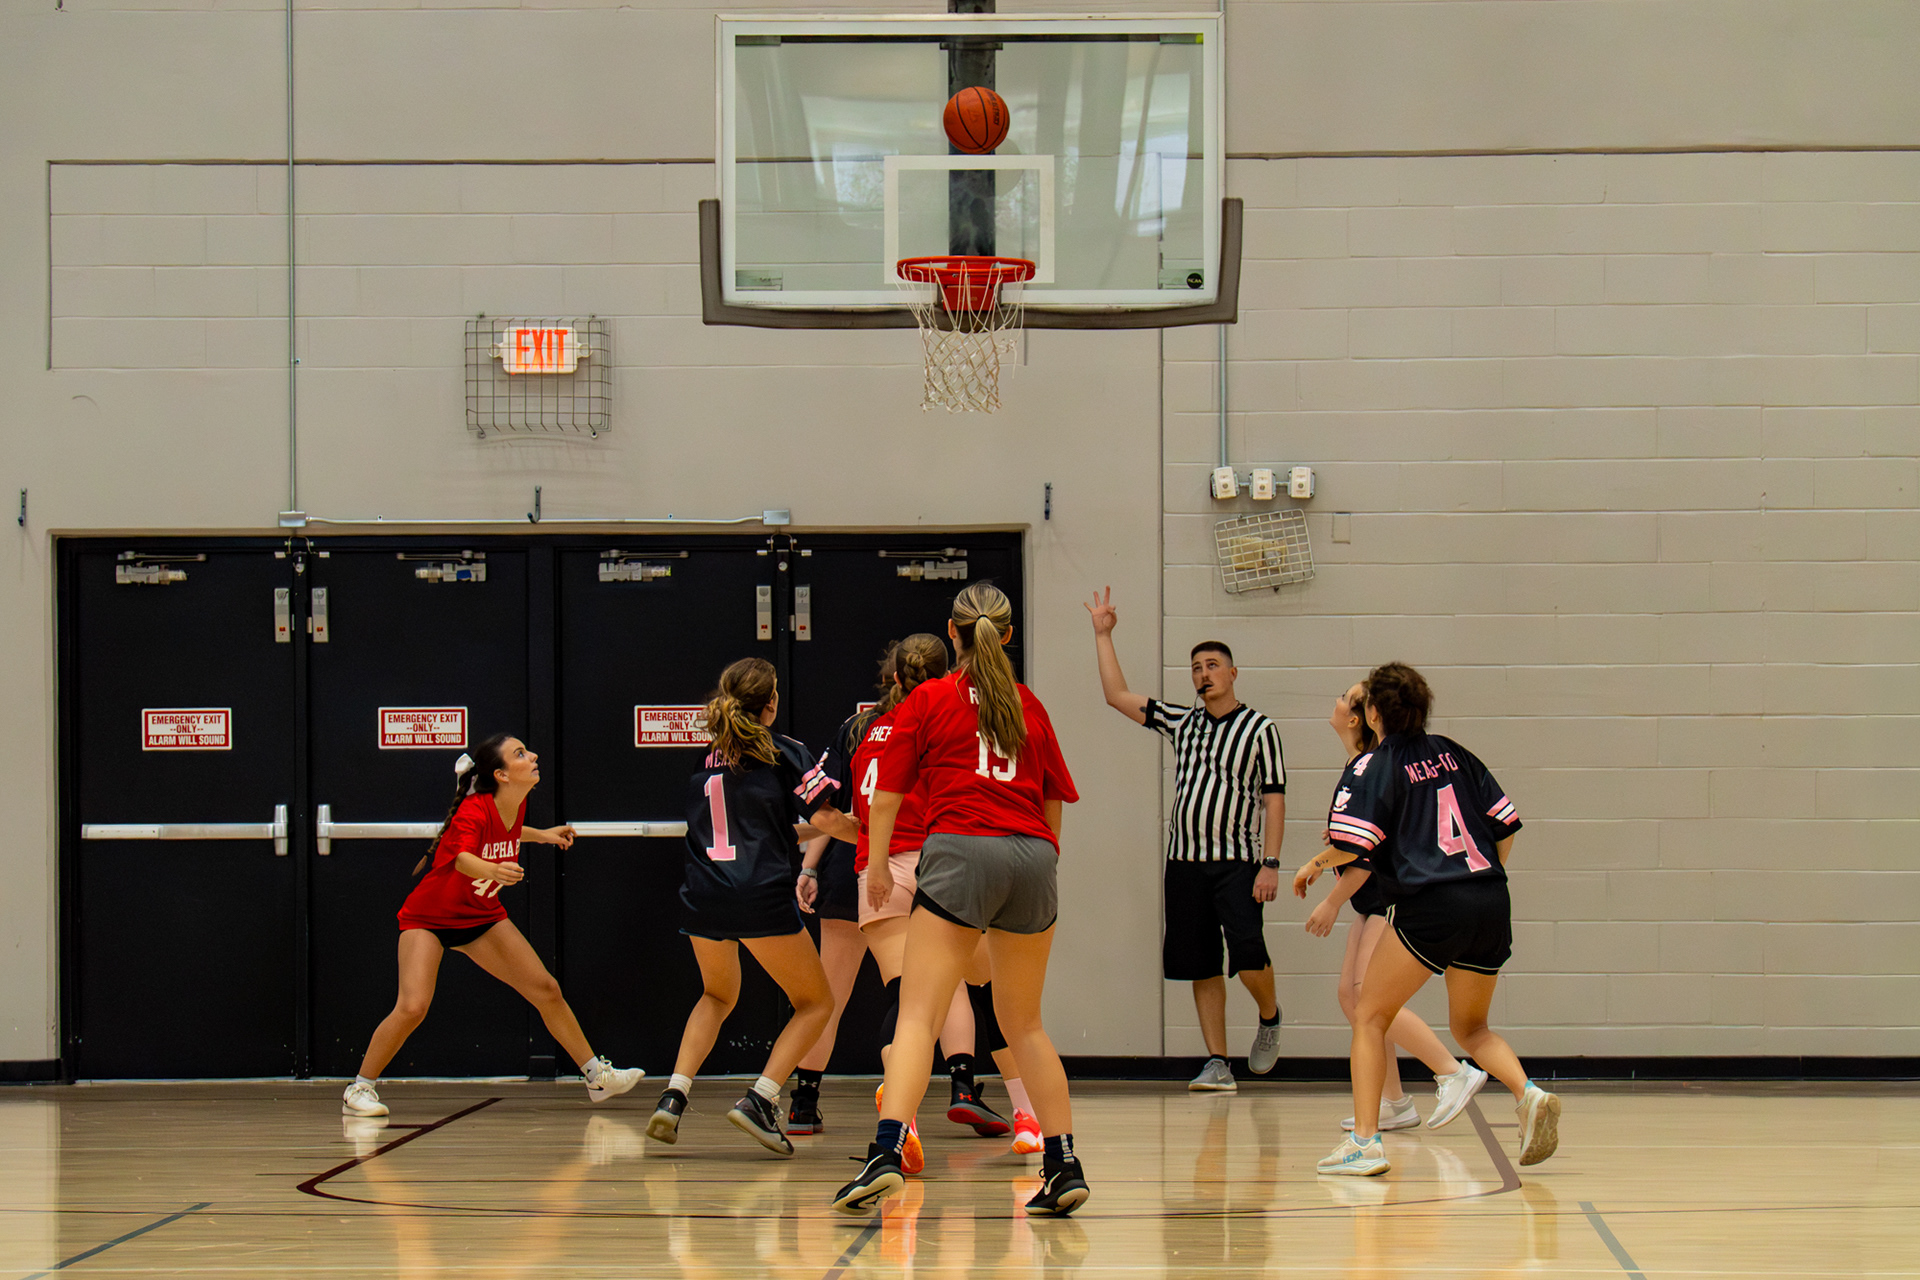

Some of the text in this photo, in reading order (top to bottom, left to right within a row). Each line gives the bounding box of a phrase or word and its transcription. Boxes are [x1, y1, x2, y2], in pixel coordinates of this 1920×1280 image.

[516, 329, 568, 369] EXIT
[151, 715, 222, 725] EMERGENCY EXIT
[387, 713, 458, 723] EMERGENCY EXIT
[644, 711, 694, 722] EMERGENCY
[148, 735, 226, 746] ALARM WILL SOUND
[384, 733, 462, 744] ALARM WILL SOUND
[641, 732, 669, 743] ALARM
[670, 732, 690, 742] WILL
[1353, 753, 1374, 777] 4
[704, 773, 737, 861] 1
[1437, 783, 1492, 873] 4
[481, 840, 514, 860] ALPHA
